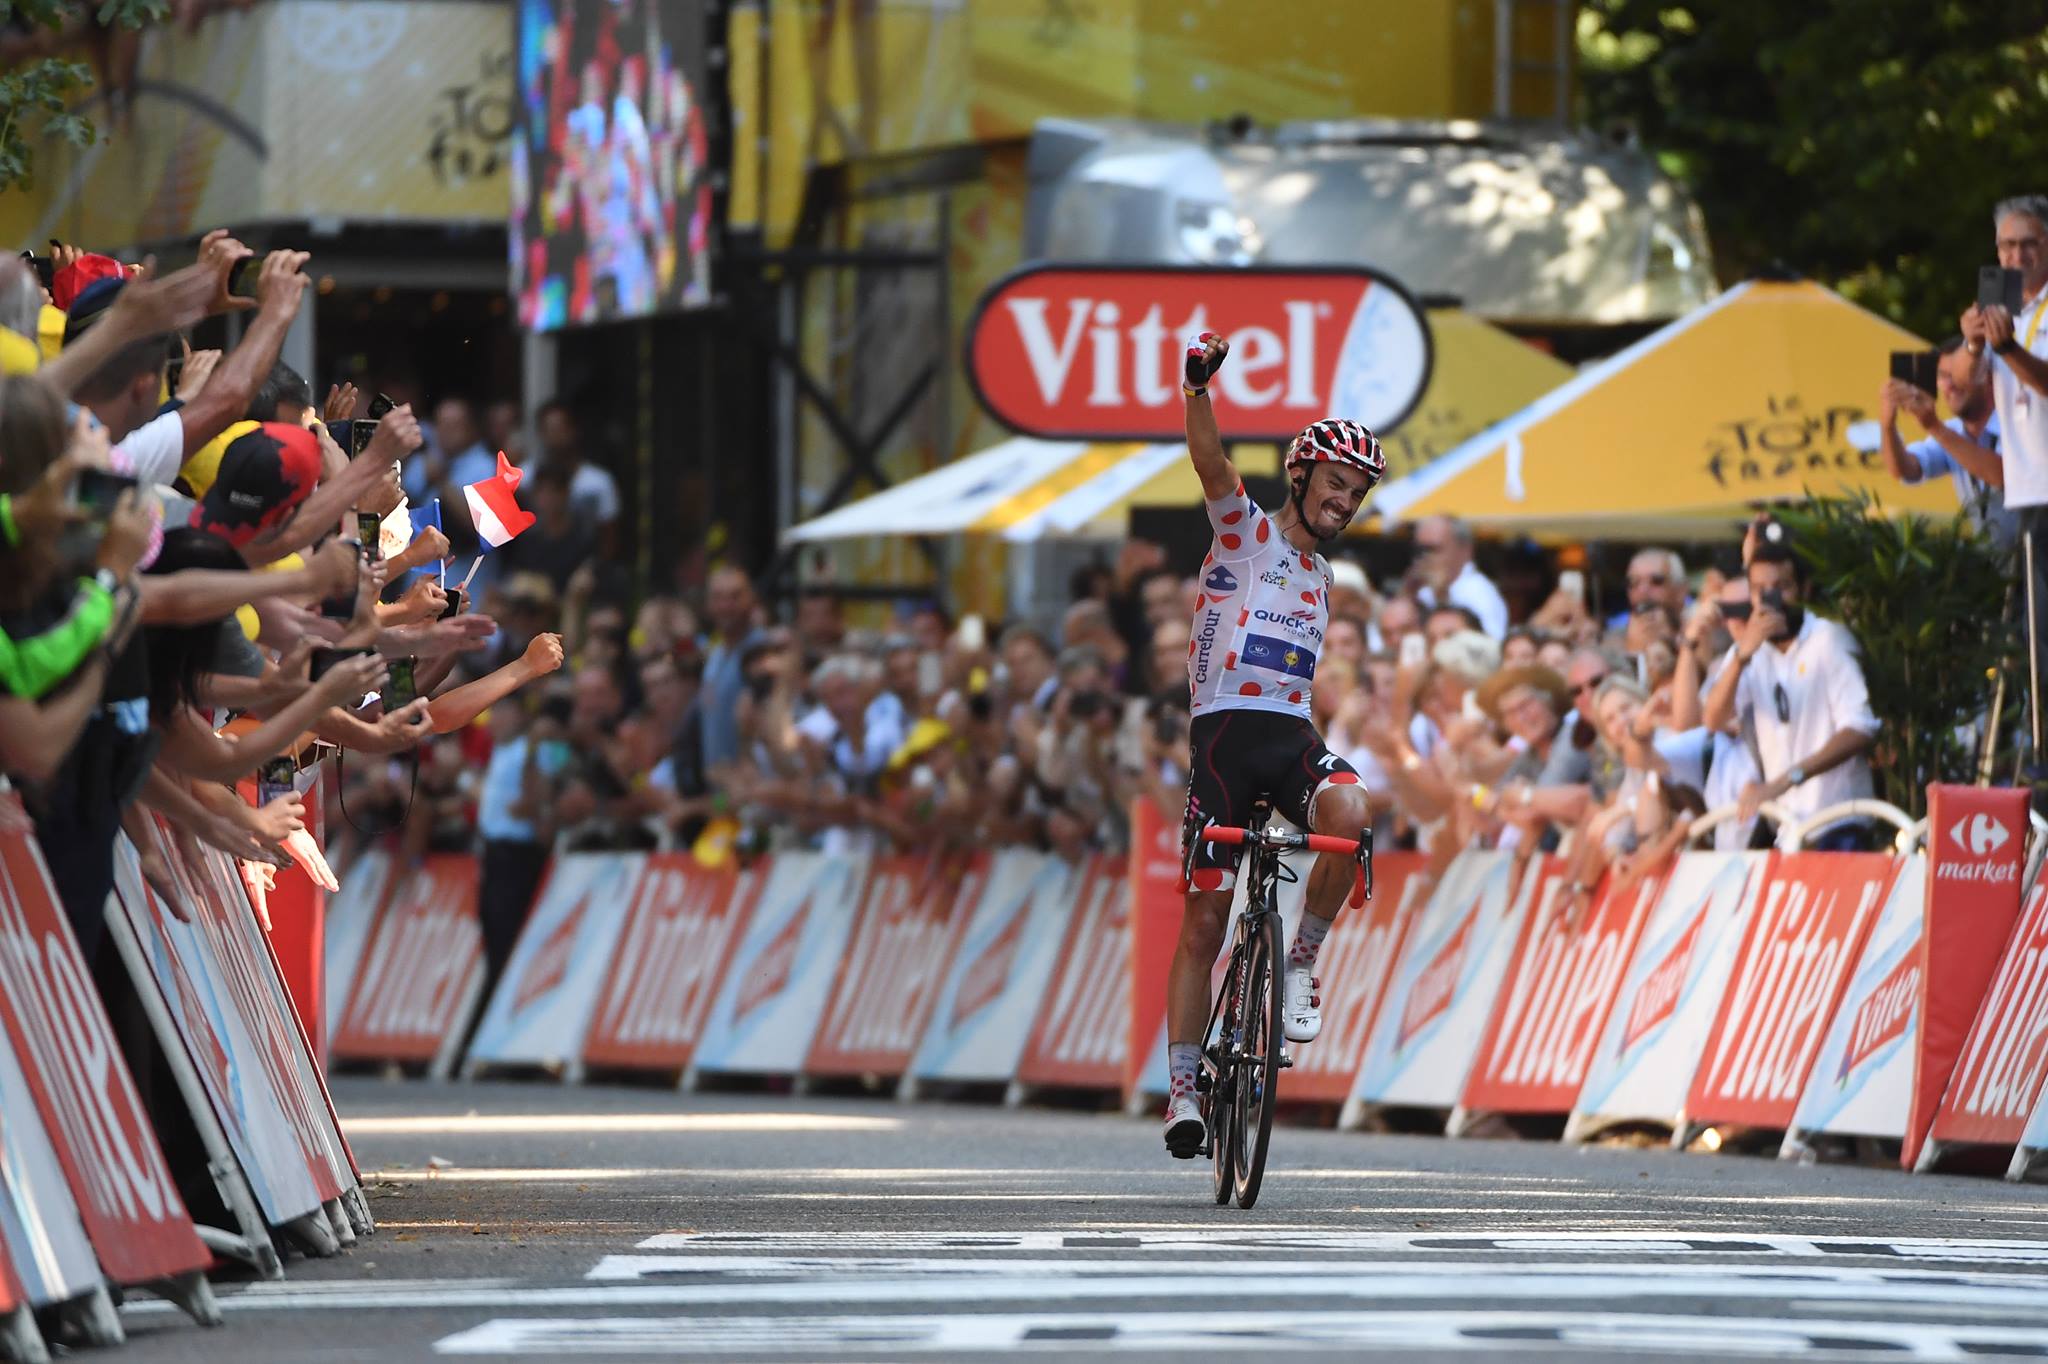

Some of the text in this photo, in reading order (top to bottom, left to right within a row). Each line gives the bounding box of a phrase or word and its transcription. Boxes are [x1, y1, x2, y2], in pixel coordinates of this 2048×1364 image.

[1195, 609, 1221, 684] Carrefour
[1936, 859, 2017, 884] market
[1703, 879, 1882, 1102] Vittel
